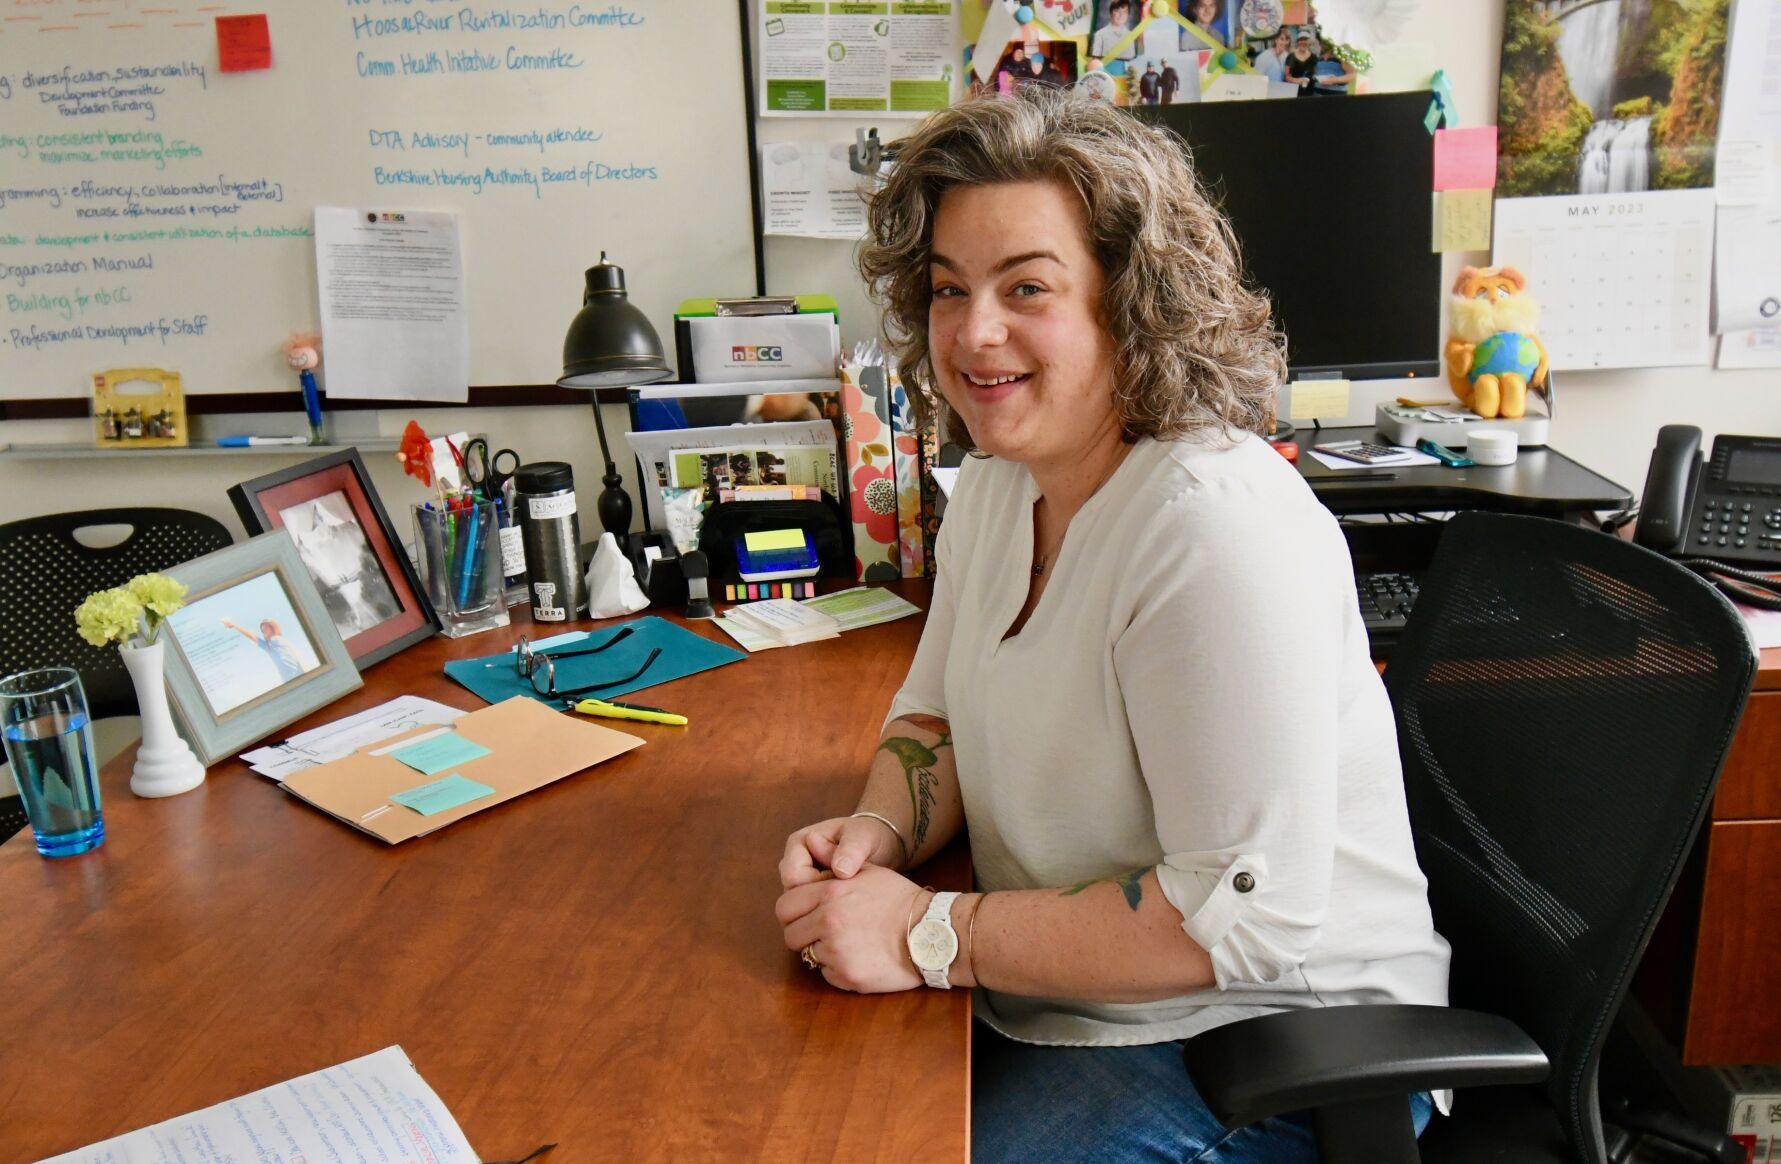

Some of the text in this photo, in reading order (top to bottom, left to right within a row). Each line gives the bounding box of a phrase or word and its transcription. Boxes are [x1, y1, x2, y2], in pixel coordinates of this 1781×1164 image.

[568, 5, 645, 28] Committee
[400, 50, 445, 75] Health
[507, 45, 584, 70] Committee
[369, 128, 405, 150] DTA
[412, 131, 469, 158] Advisory
[541, 165, 576, 183] Board
[579, 160, 594, 186] of
[595, 162, 657, 180] Directors
[197, 203, 242, 218] impact
[1568, 203, 1644, 217] MAY 2023
[92, 252, 152, 272] Manual
[172, 314, 209, 336] Staff
[535, 609, 563, 617] TERRA
